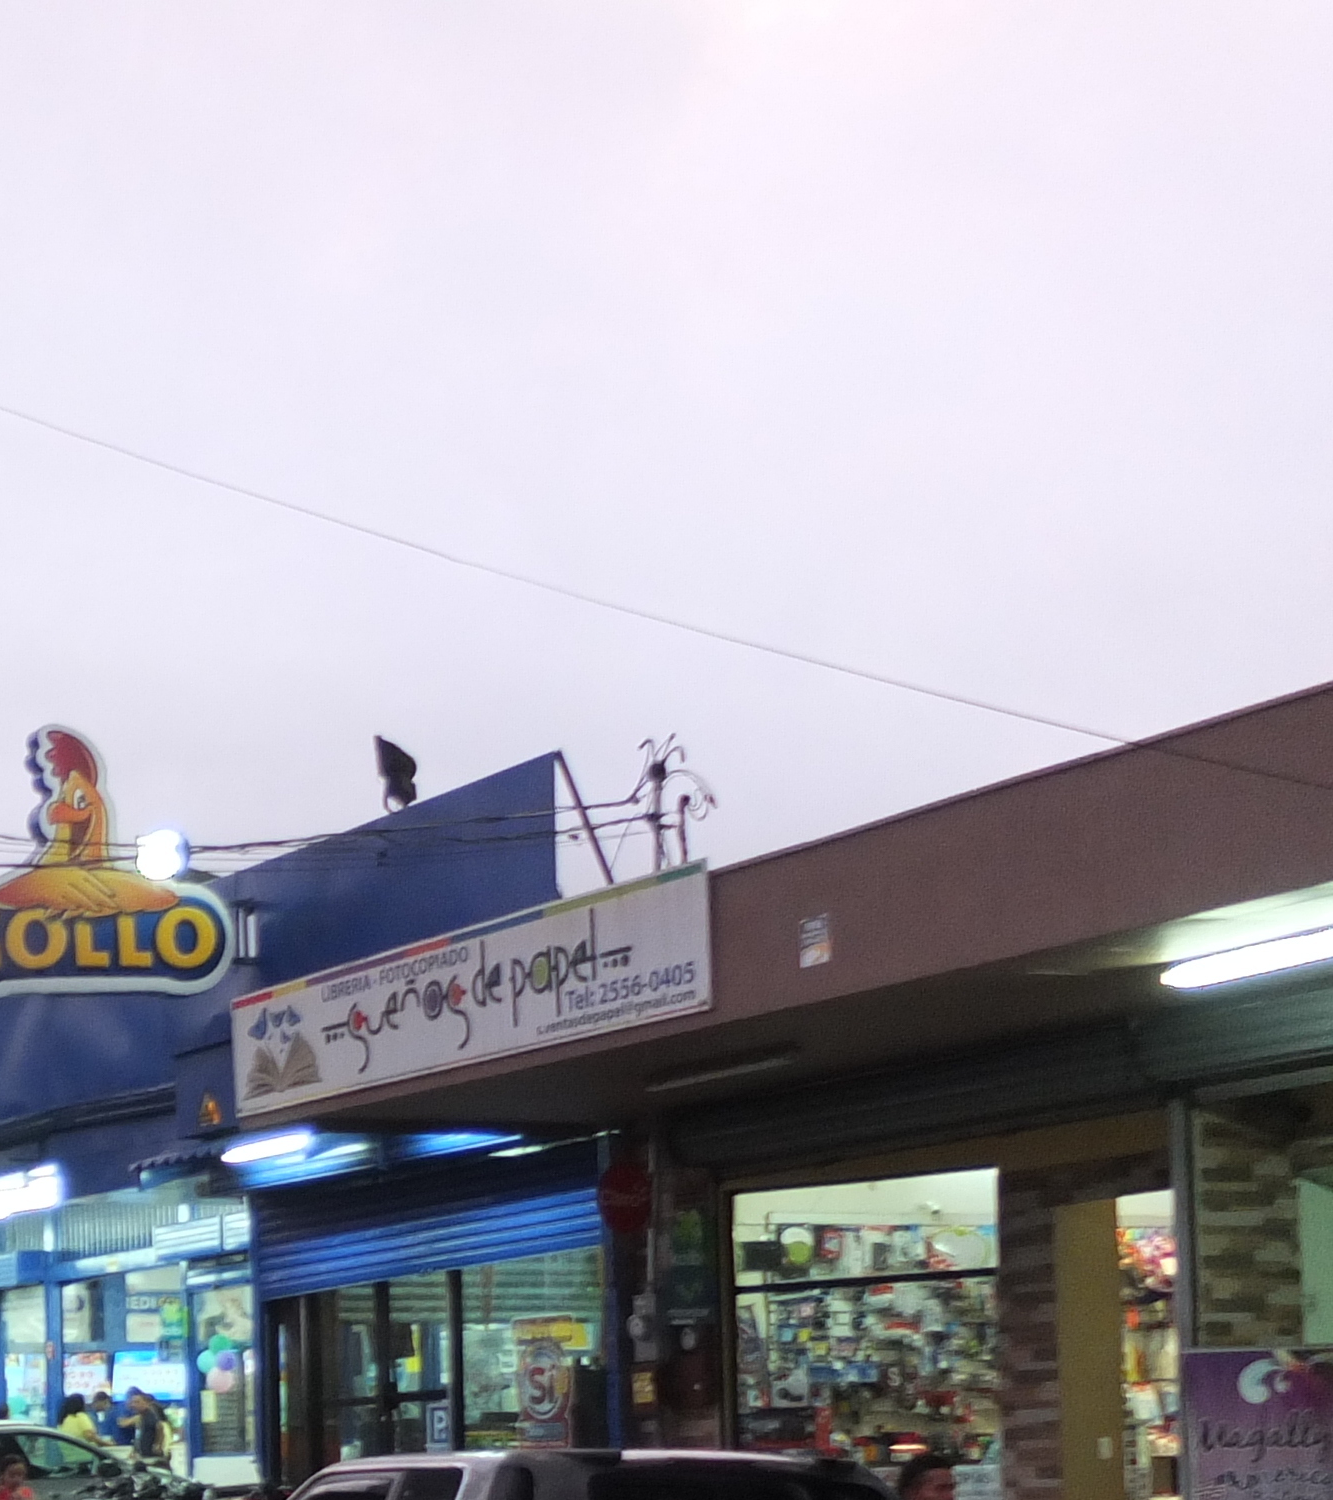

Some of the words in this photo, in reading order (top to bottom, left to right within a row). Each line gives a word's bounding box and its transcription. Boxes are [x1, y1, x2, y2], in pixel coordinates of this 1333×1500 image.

[378, 946, 469, 986] FOTOCOPIADO
[565, 989, 594, 1013] Tel:
[598, 960, 696, 1005] 2556-0405
